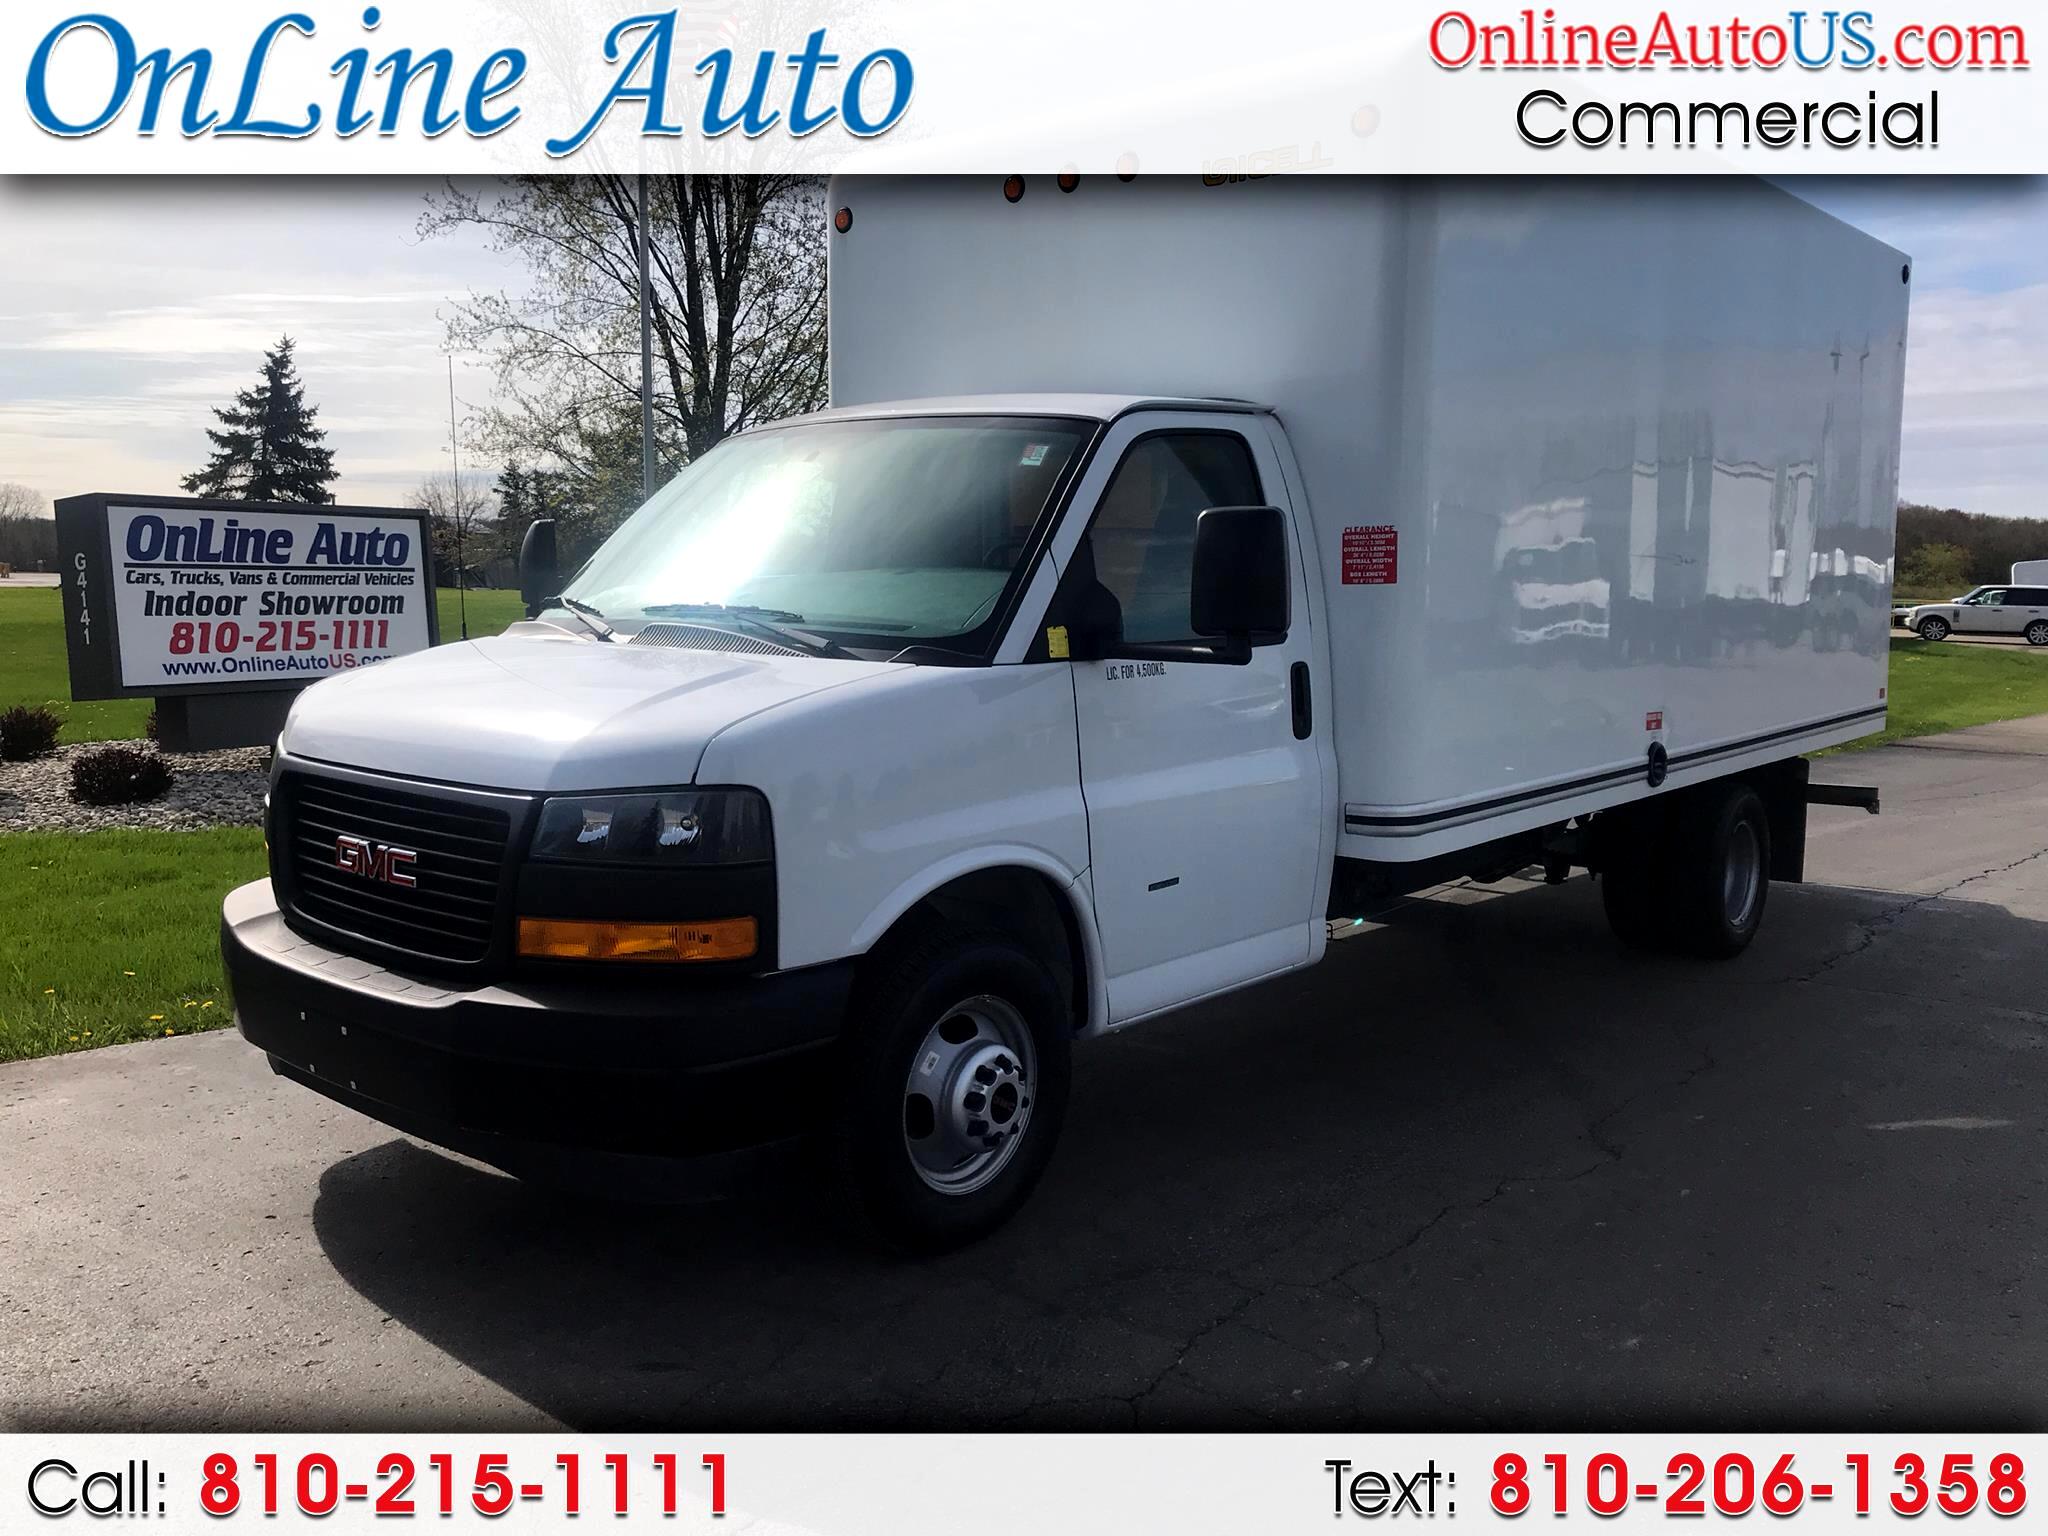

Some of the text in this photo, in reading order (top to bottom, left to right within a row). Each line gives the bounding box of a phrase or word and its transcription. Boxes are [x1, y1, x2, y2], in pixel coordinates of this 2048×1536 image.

[126, 514, 410, 566] OnLine Auto
[126, 570, 415, 586] Cars, Trucks, Vans & Commercial Vehicles
[144, 590, 405, 616] Indoor Showroom
[169, 620, 389, 655] 810-215-1111
[1121, 664, 1135, 679] FOR
[335, 835, 417, 888] GMC
